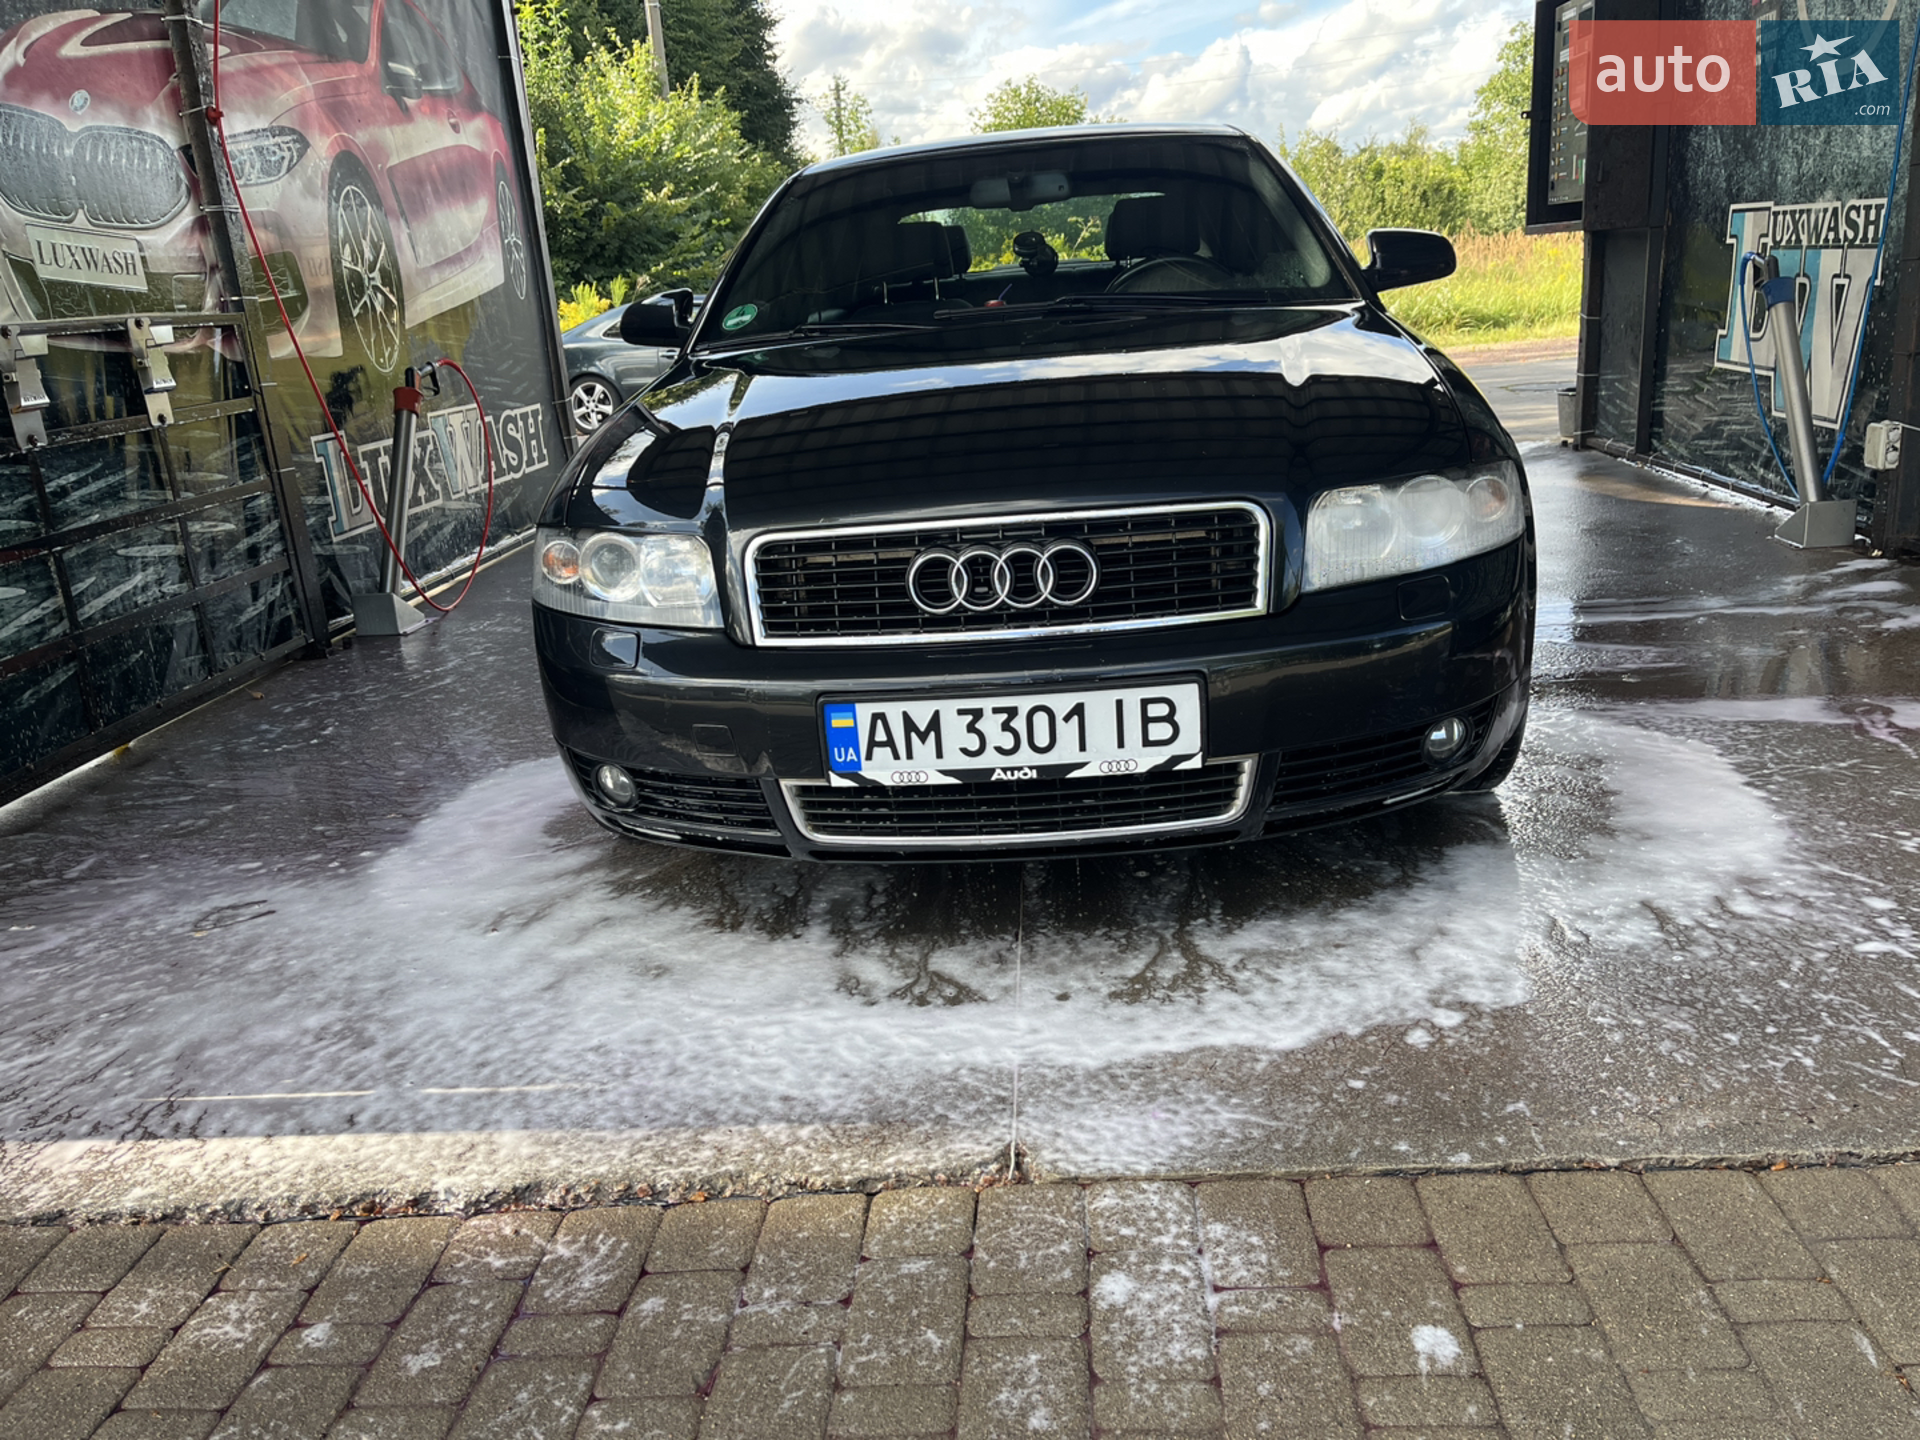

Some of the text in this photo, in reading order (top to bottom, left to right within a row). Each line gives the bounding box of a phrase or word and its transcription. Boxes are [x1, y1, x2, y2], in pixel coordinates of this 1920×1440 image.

[35, 239, 139, 277] LUXWASH
[864, 696, 1181, 762] AM 3301 IB
[834, 746, 858, 764] UA
[990, 766, 1038, 781] Audi
